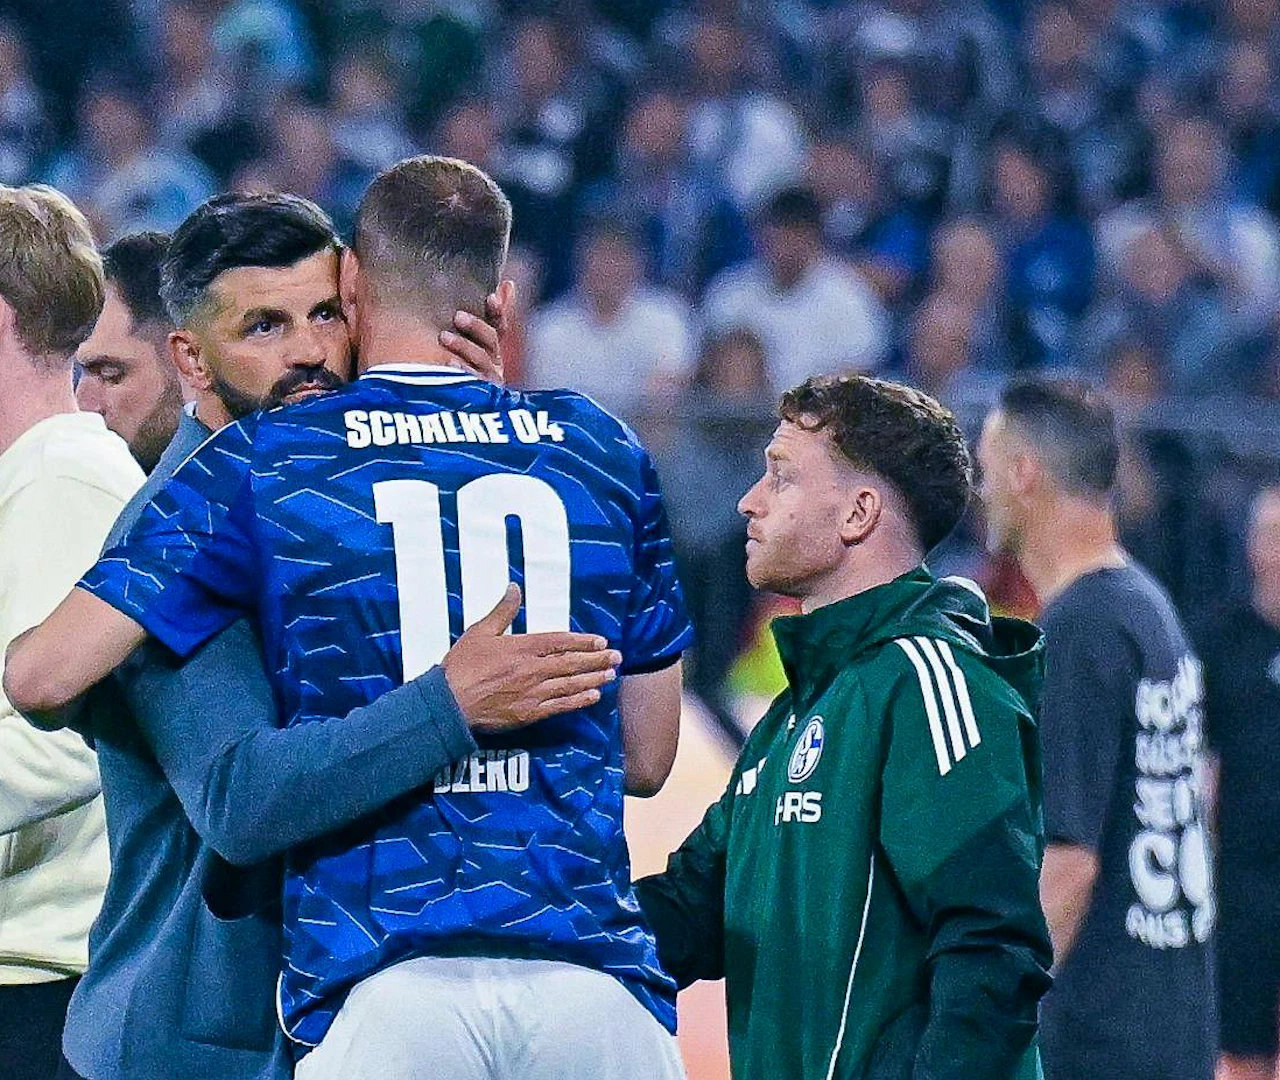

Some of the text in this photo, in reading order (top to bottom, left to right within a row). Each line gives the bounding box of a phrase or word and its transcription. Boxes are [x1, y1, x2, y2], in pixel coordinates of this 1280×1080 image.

[344, 408, 566, 449] SCHALKE 04
[372, 472, 571, 686] 10
